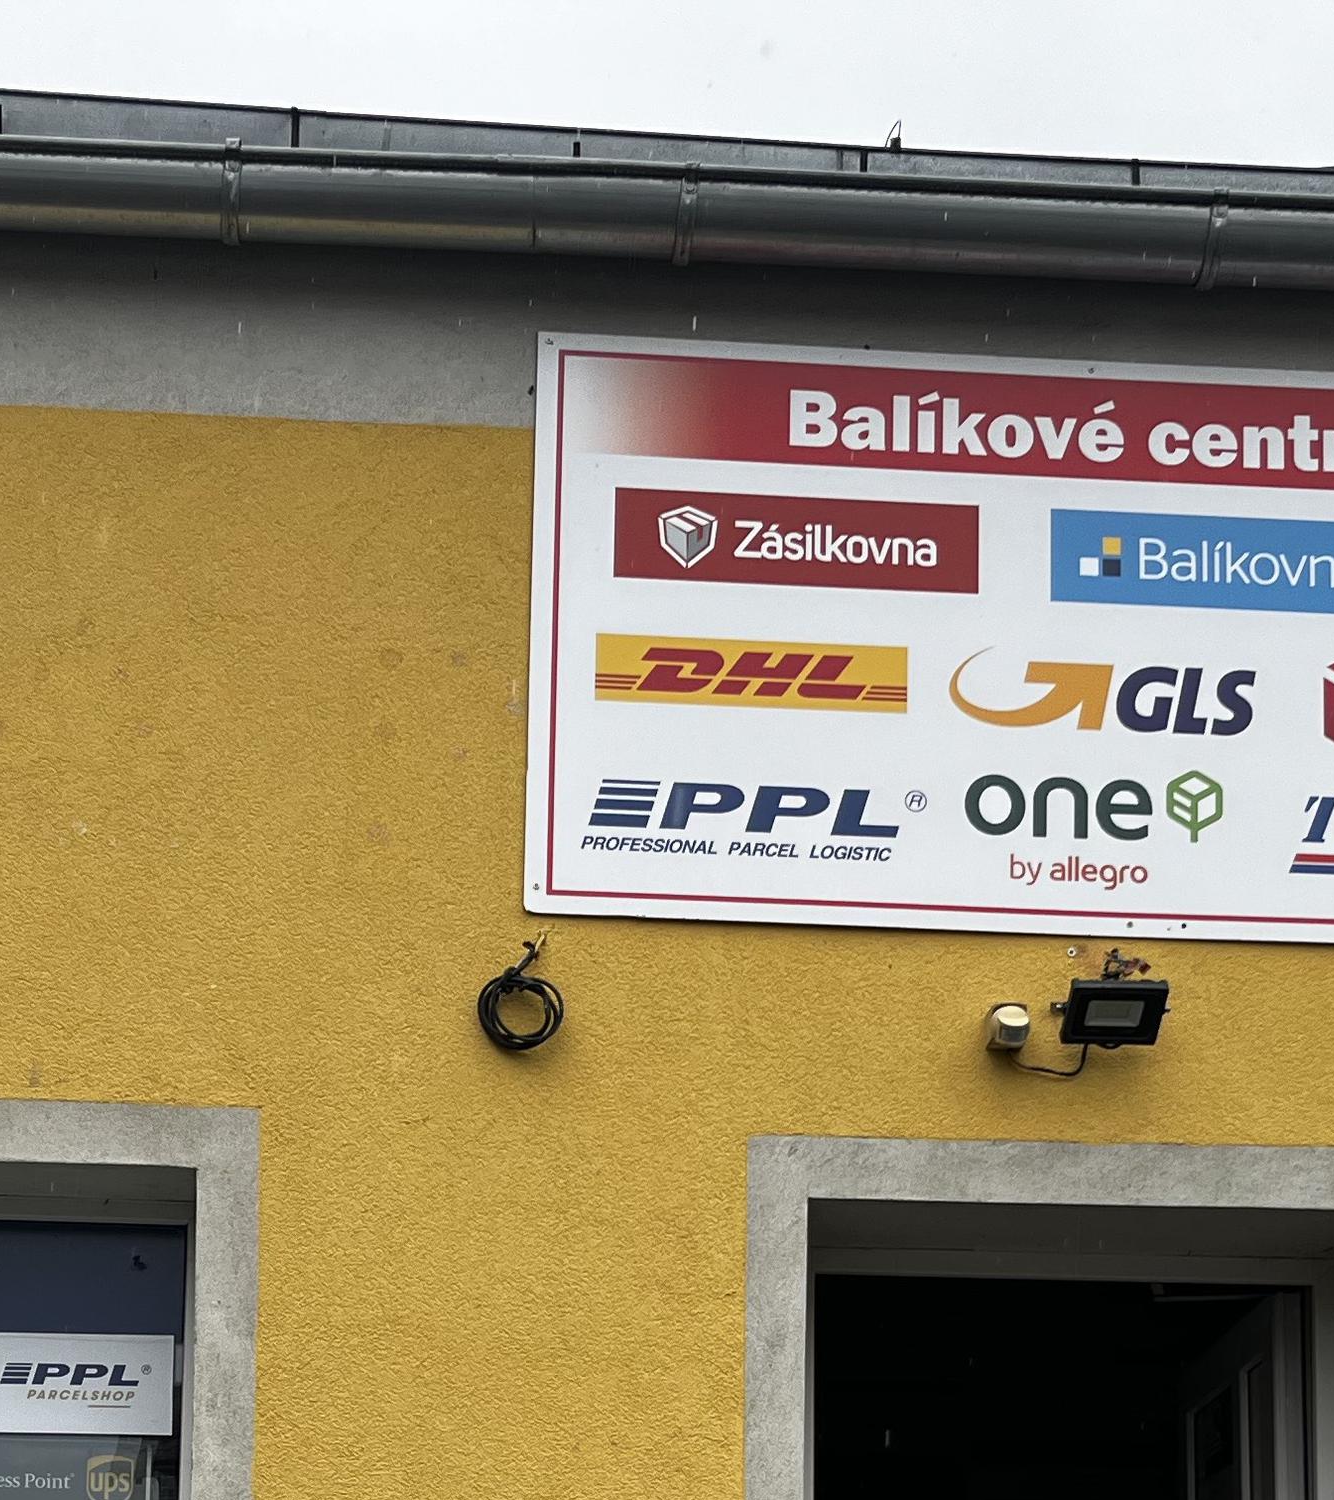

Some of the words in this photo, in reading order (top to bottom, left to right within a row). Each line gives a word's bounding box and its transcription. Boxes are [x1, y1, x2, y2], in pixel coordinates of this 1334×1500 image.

[788, 388, 1125, 463] Balíkové
[733, 519, 938, 568] Zásilkovna
[635, 646, 866, 701] DHL
[1115, 665, 1257, 736] GLS
[659, 781, 900, 838] PPL
[964, 773, 1153, 841] one
[580, 835, 717, 856] PROFESSIONAL
[727, 841, 799, 859] PARCEL
[809, 844, 892, 862] LOGISTIC
[1009, 852, 1042, 886] by
[1049, 855, 1149, 891] allegro
[27, 1389, 135, 1401] PARCELSHOP
[31, 1363, 140, 1387] PPL
[90, 1471, 132, 1500] ups
